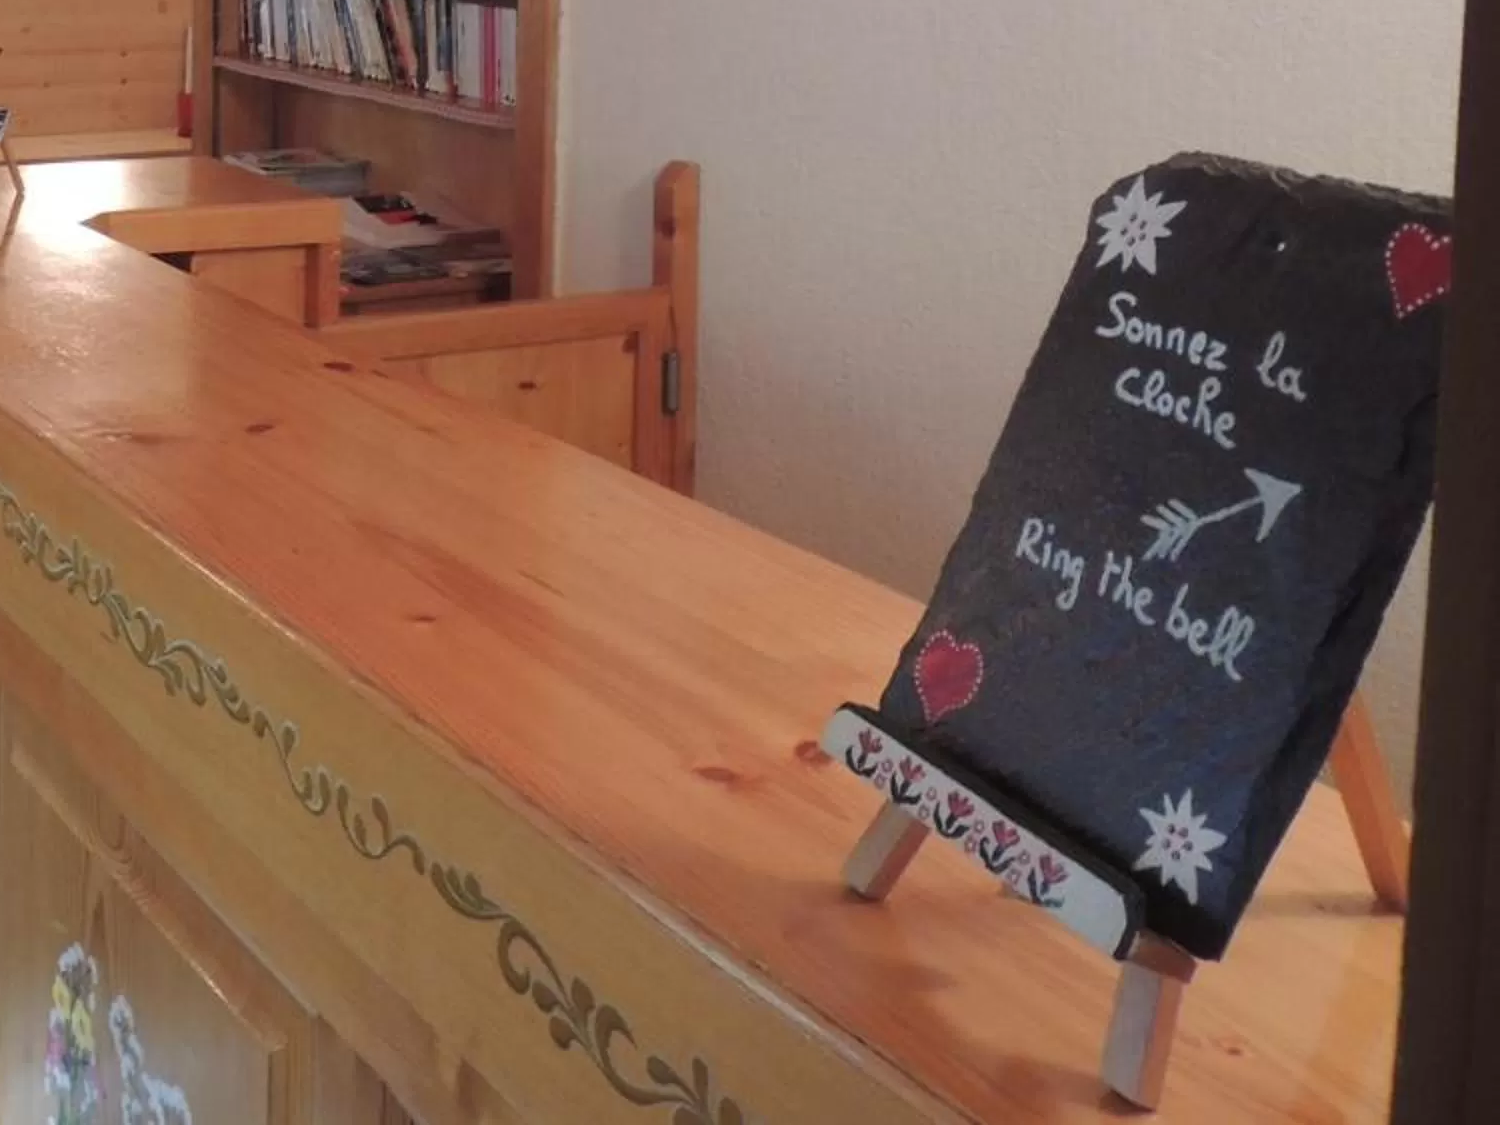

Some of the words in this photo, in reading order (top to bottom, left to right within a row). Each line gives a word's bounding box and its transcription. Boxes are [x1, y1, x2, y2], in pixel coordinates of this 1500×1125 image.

[1095, 290, 1228, 371] Sonnez
[1256, 330, 1307, 403] la
[1015, 517, 1085, 611] Ring
[1097, 550, 1156, 626] the
[1165, 583, 1255, 681] bell
